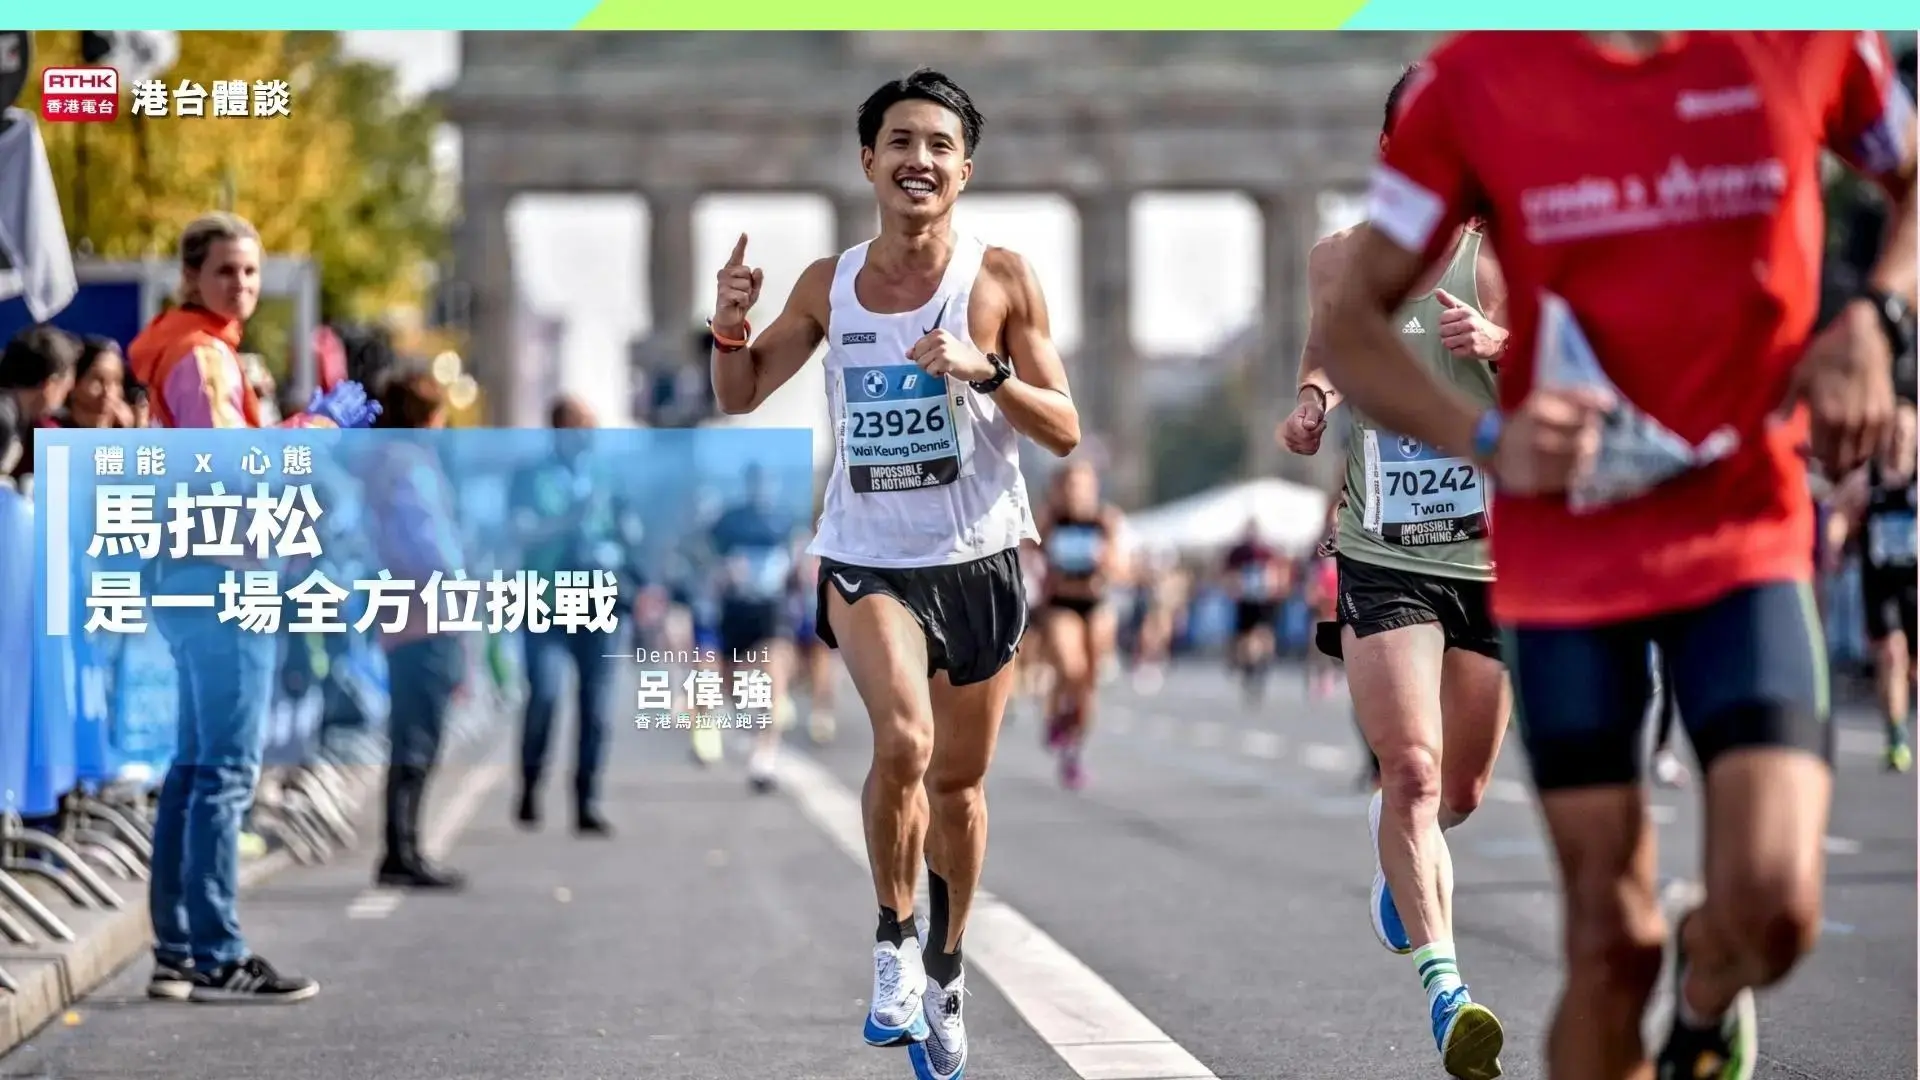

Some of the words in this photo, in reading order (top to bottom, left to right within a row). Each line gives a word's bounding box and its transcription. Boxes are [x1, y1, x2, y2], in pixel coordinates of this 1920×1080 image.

[956, 396, 965, 406] B
[853, 404, 944, 438] 23926
[852, 446, 873, 457] Wai
[873, 444, 910, 457] Keung
[911, 440, 950, 455] Dennis
[870, 464, 924, 480] IMPOSSIBLE
[871, 478, 881, 490] IS
[881, 475, 922, 490] NOTHING
[1386, 465, 1476, 497] 70242
[1411, 502, 1455, 516] Twan
[1401, 519, 1454, 535] IMPOSSIBLE
[1401, 534, 1411, 546] IS
[1411, 530, 1452, 544] NOTHING
